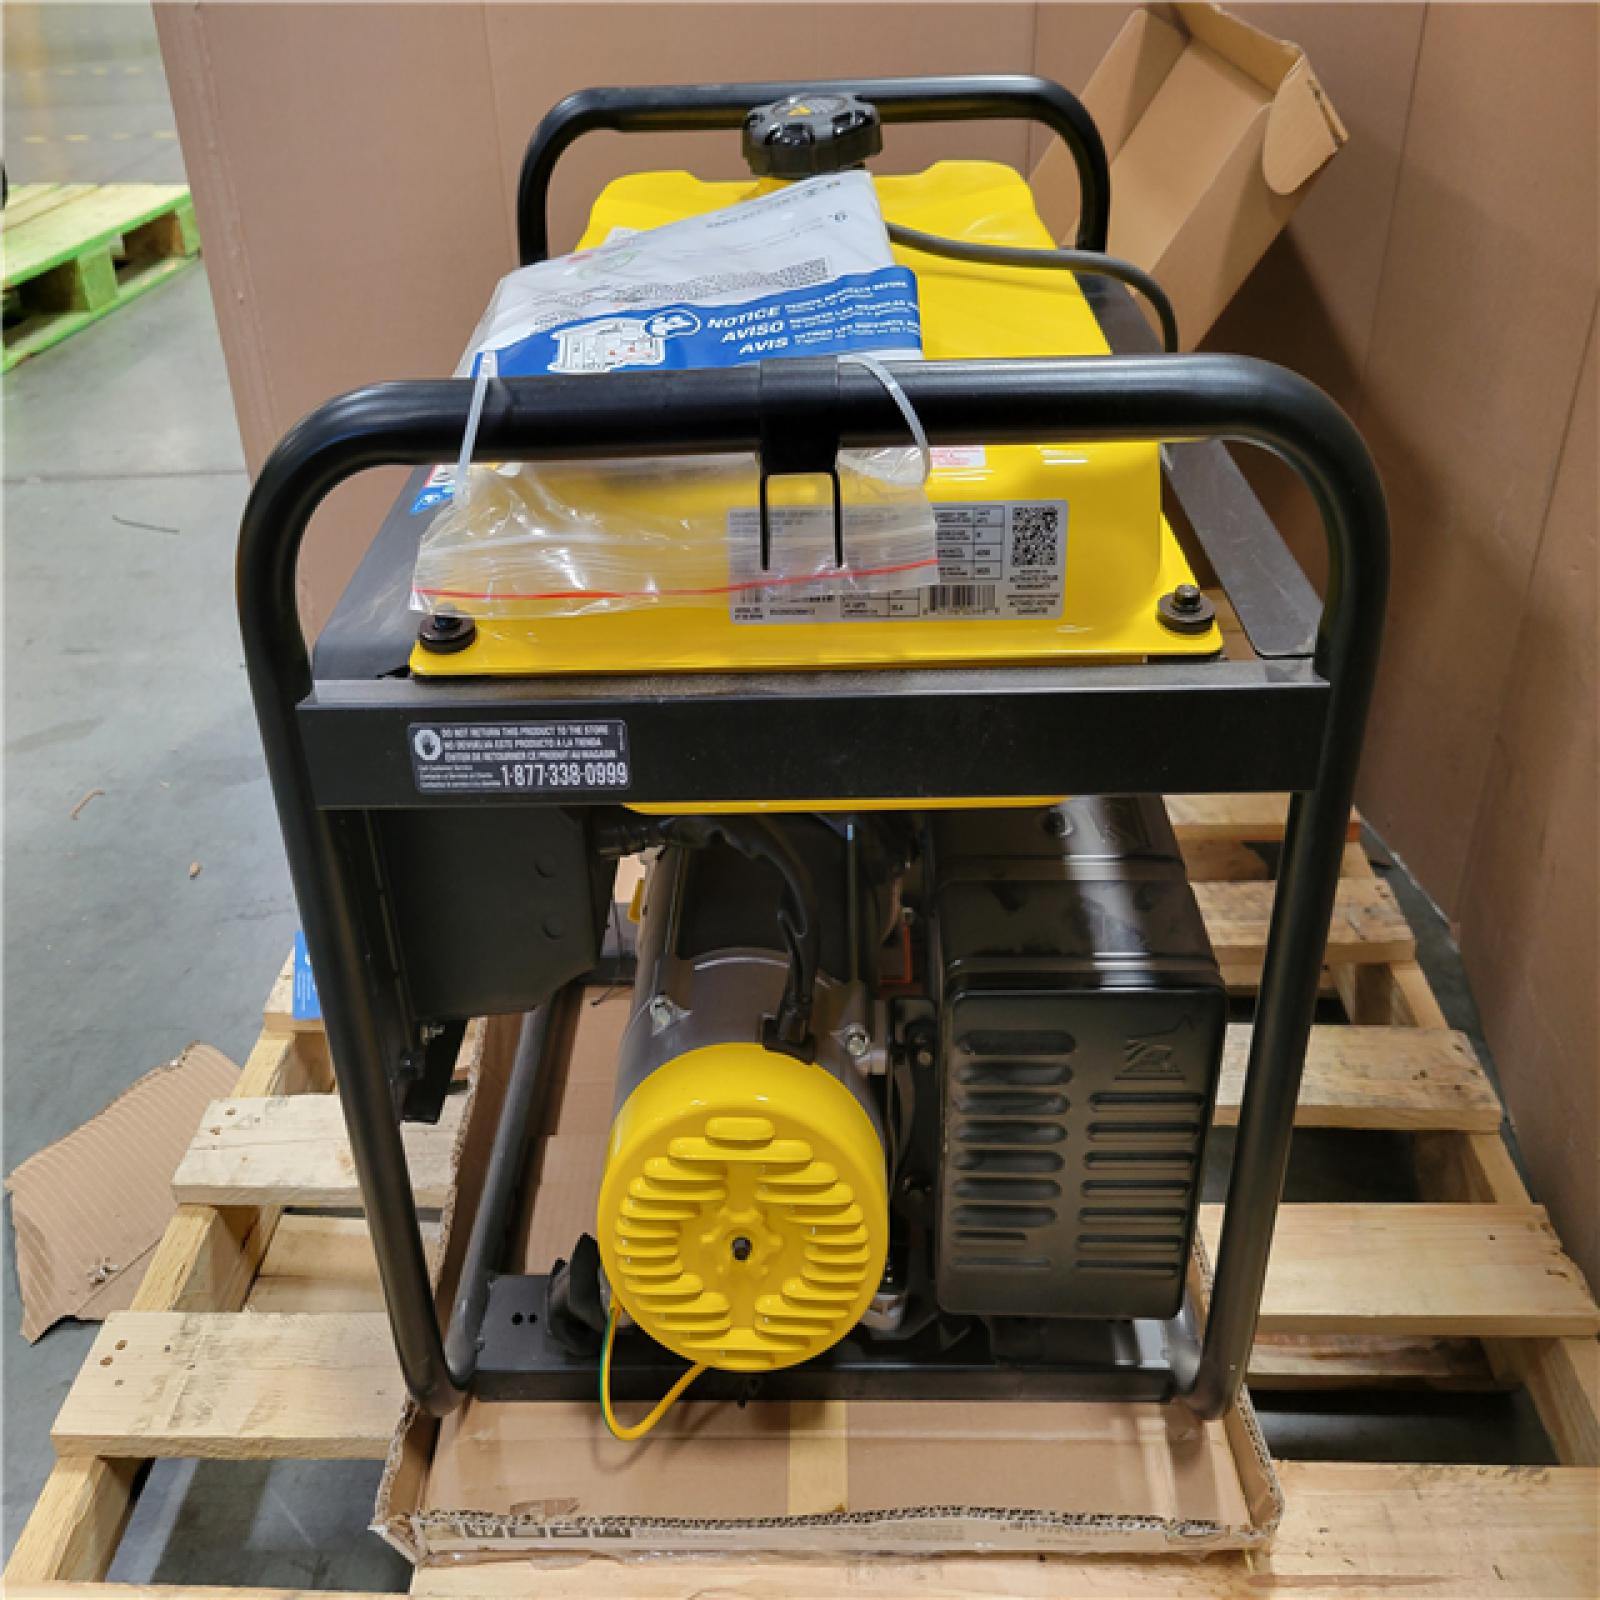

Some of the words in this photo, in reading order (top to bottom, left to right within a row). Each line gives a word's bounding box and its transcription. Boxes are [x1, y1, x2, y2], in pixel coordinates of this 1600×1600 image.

[707, 305, 780, 328] NOTICE
[721, 320, 783, 342] AVISO
[739, 337, 788, 354] AVIS
